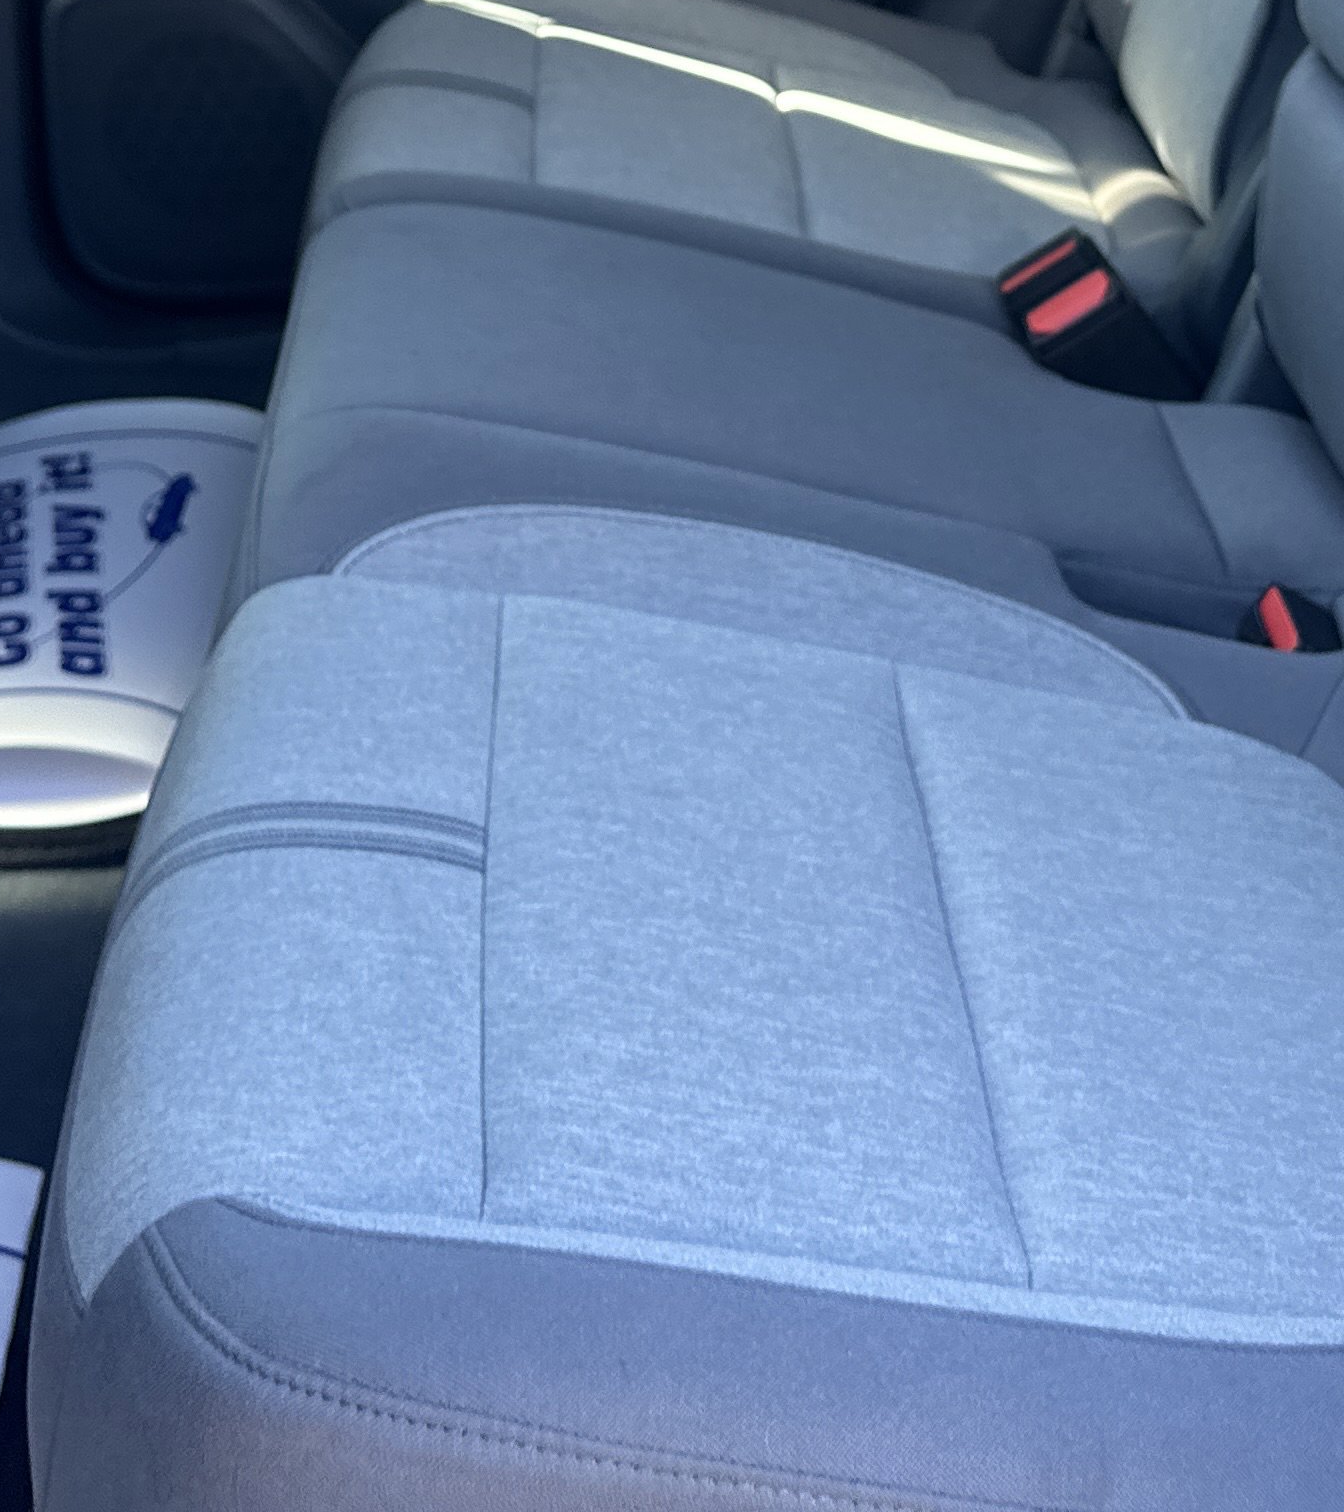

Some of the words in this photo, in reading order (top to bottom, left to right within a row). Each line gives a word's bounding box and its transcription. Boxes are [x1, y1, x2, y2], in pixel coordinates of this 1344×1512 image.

[37, 450, 93, 492] it!
[45, 504, 105, 576] buy
[46, 588, 106, 677] and
